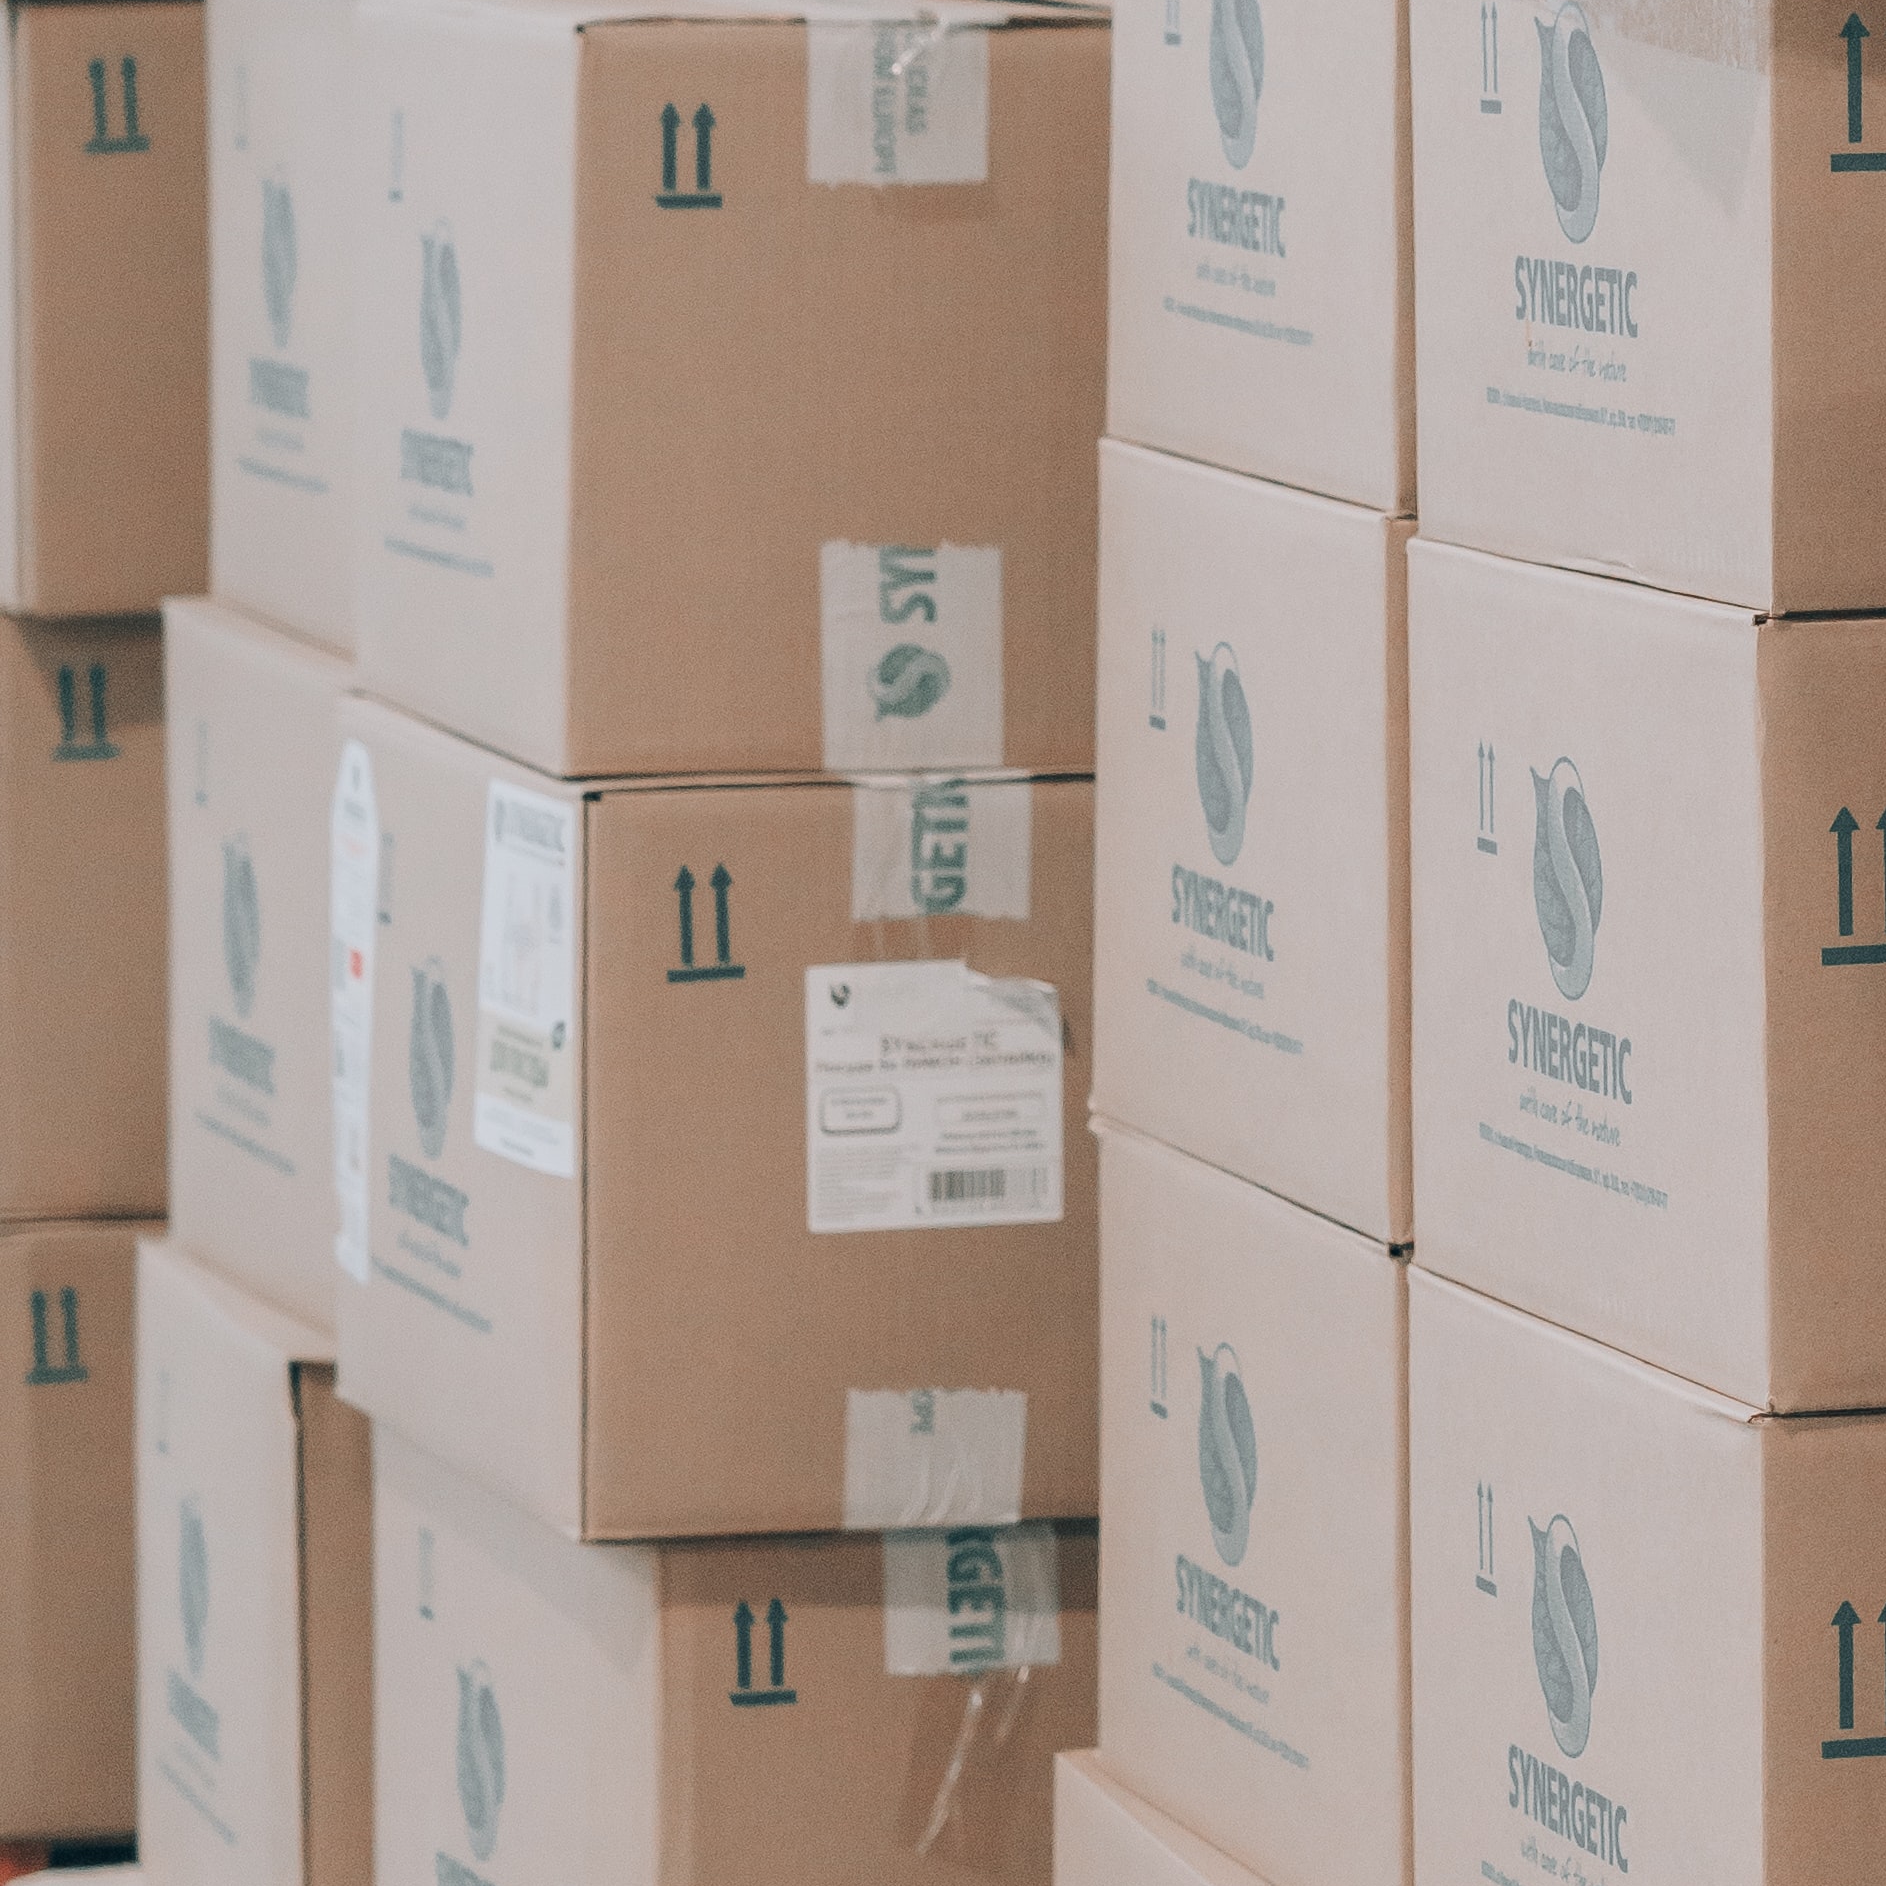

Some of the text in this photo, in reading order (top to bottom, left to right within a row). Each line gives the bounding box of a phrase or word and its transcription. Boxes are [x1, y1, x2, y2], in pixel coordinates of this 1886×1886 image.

[1514, 255, 1639, 339] SYNERGETIC
[1507, 998, 1632, 1105] SYNERGETIC
[1507, 1743, 1629, 1874] SYNERGETIC
